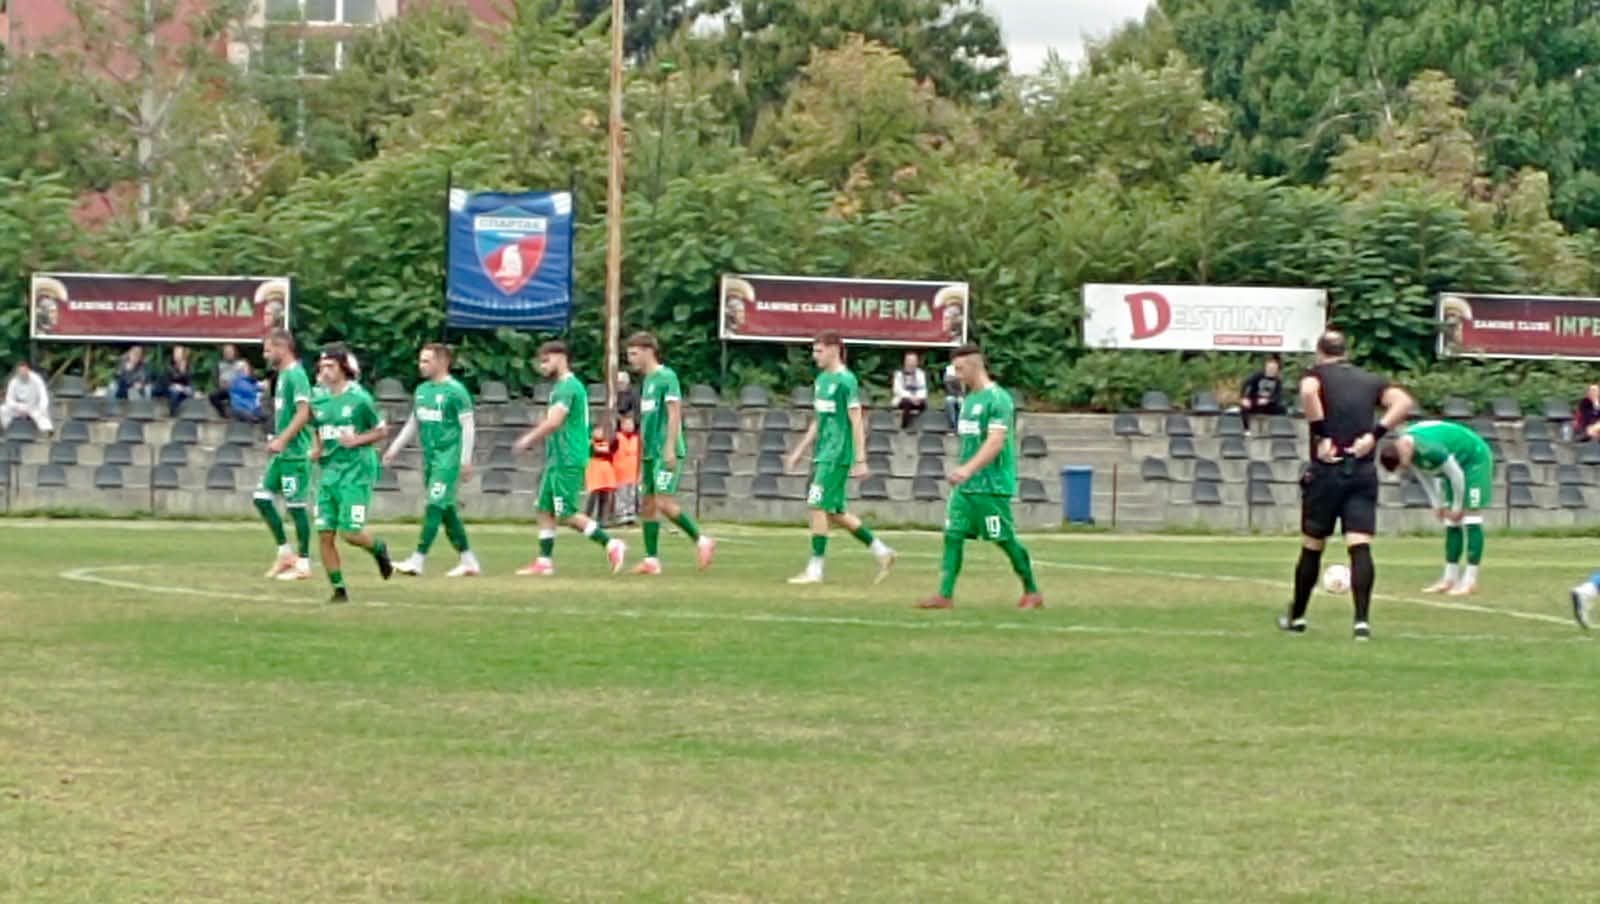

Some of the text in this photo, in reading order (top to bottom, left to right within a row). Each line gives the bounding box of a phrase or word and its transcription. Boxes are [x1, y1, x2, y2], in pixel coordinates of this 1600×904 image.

[158, 295, 253, 317] IMPERIA
[841, 297, 933, 320] IMPERIA
[1124, 291, 1294, 340] DESTINY
